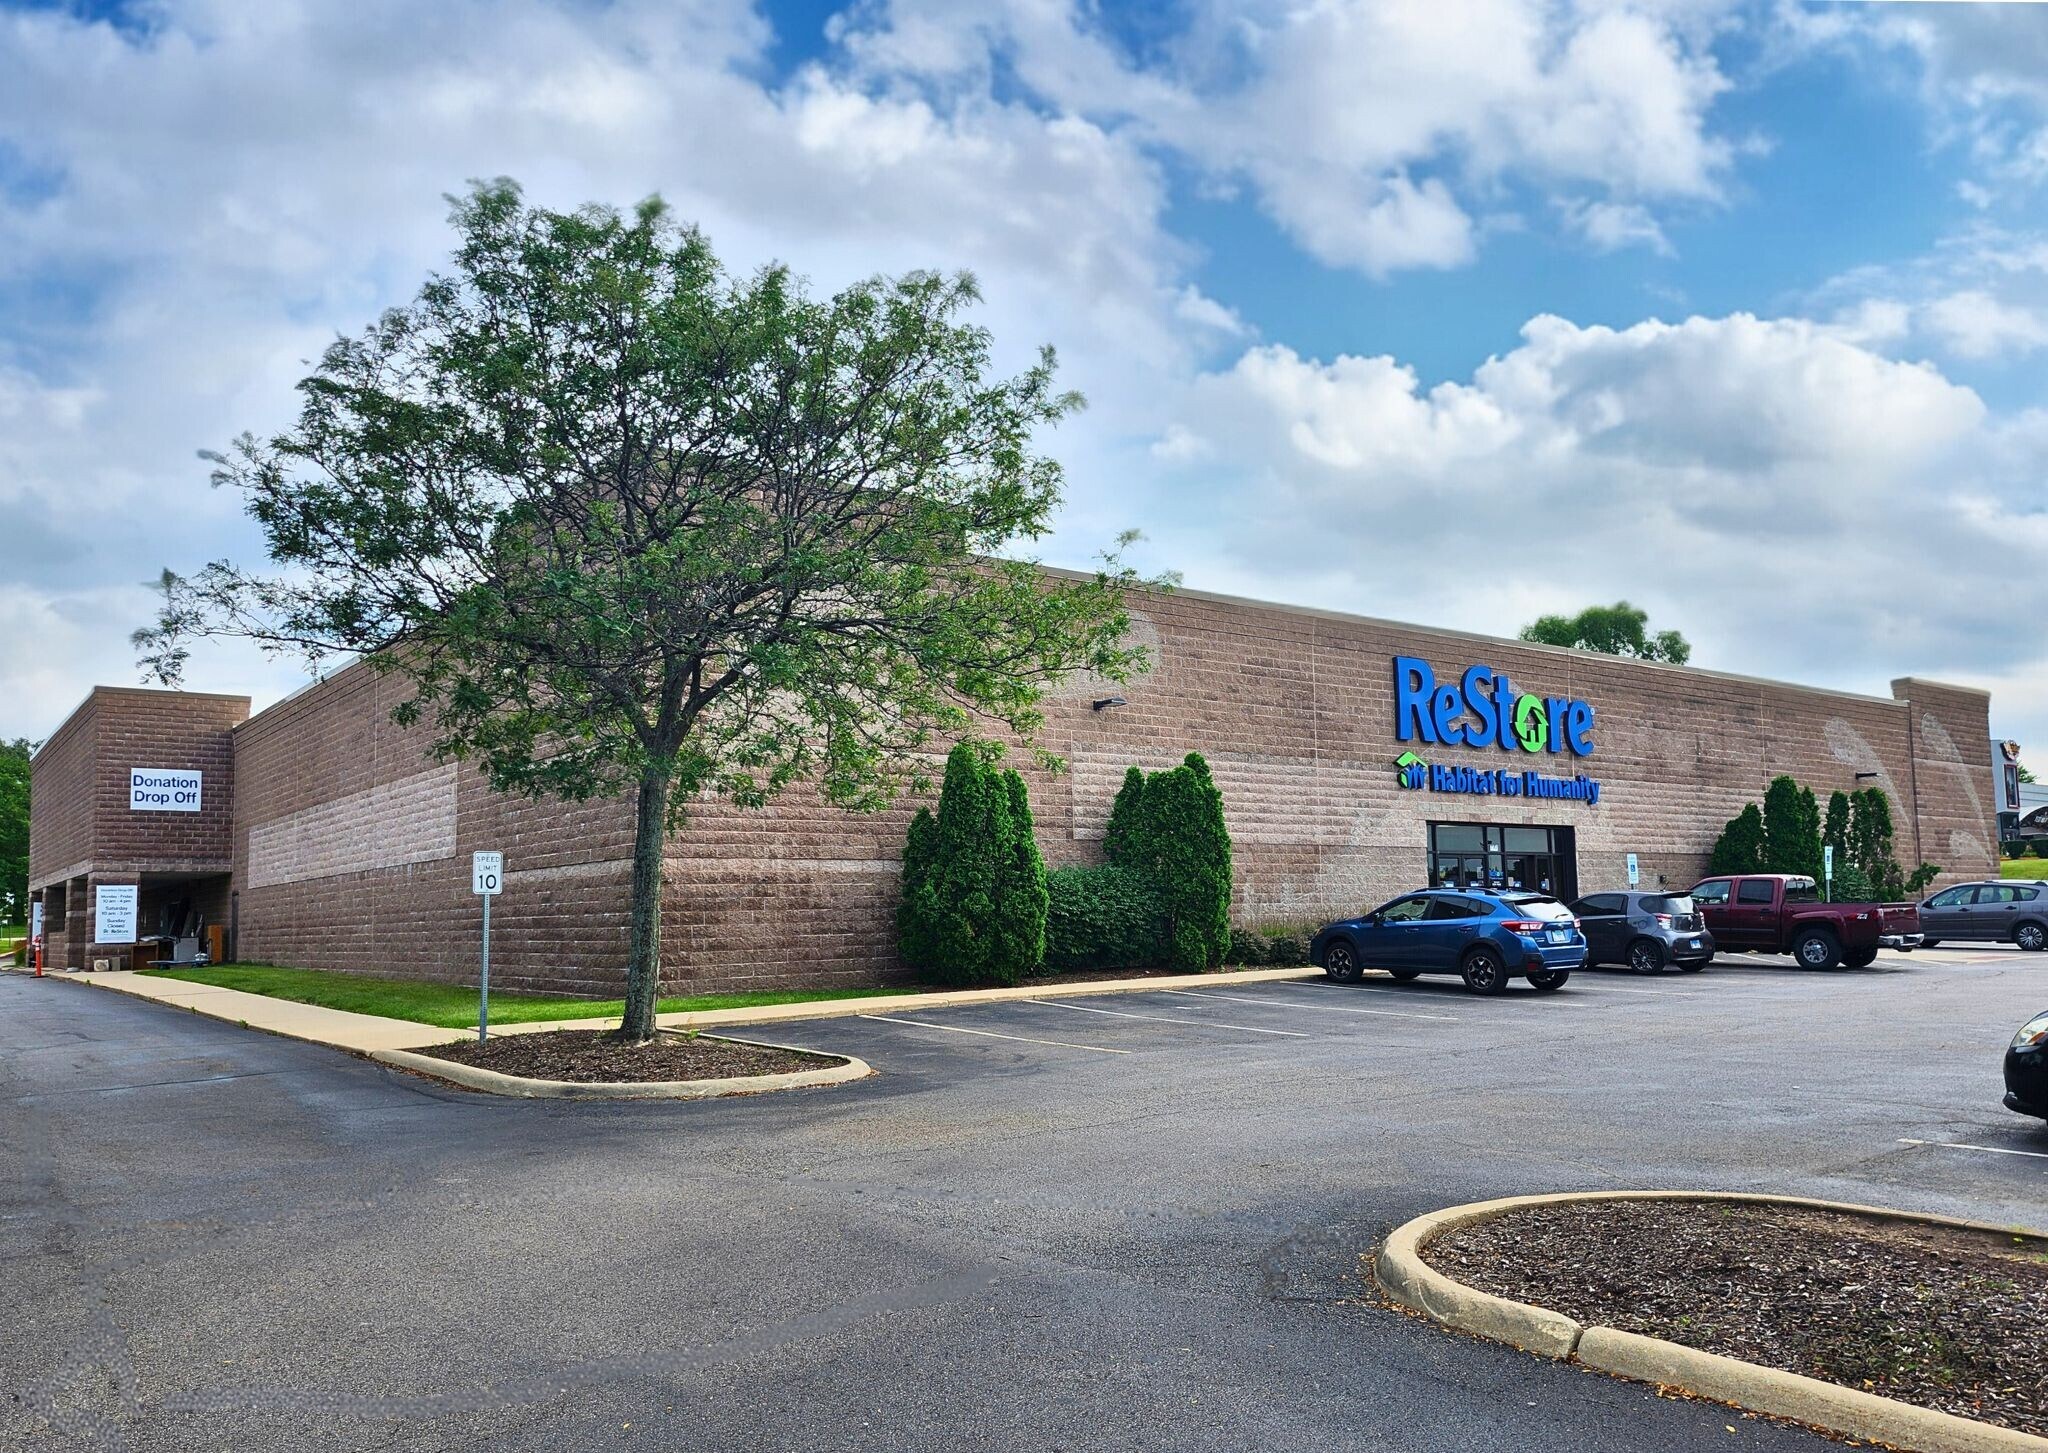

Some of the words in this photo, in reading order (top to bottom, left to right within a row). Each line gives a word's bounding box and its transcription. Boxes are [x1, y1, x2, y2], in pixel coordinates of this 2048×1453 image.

[1392, 655, 1594, 757] ReStore
[133, 774, 198, 789] Donation
[1428, 764, 1496, 794] Habitat
[1496, 769, 1523, 796] for
[1522, 771, 1600, 806] Humanity
[134, 790, 170, 805] Drop
[174, 791, 197, 803] Off
[478, 874, 497, 889] 10
